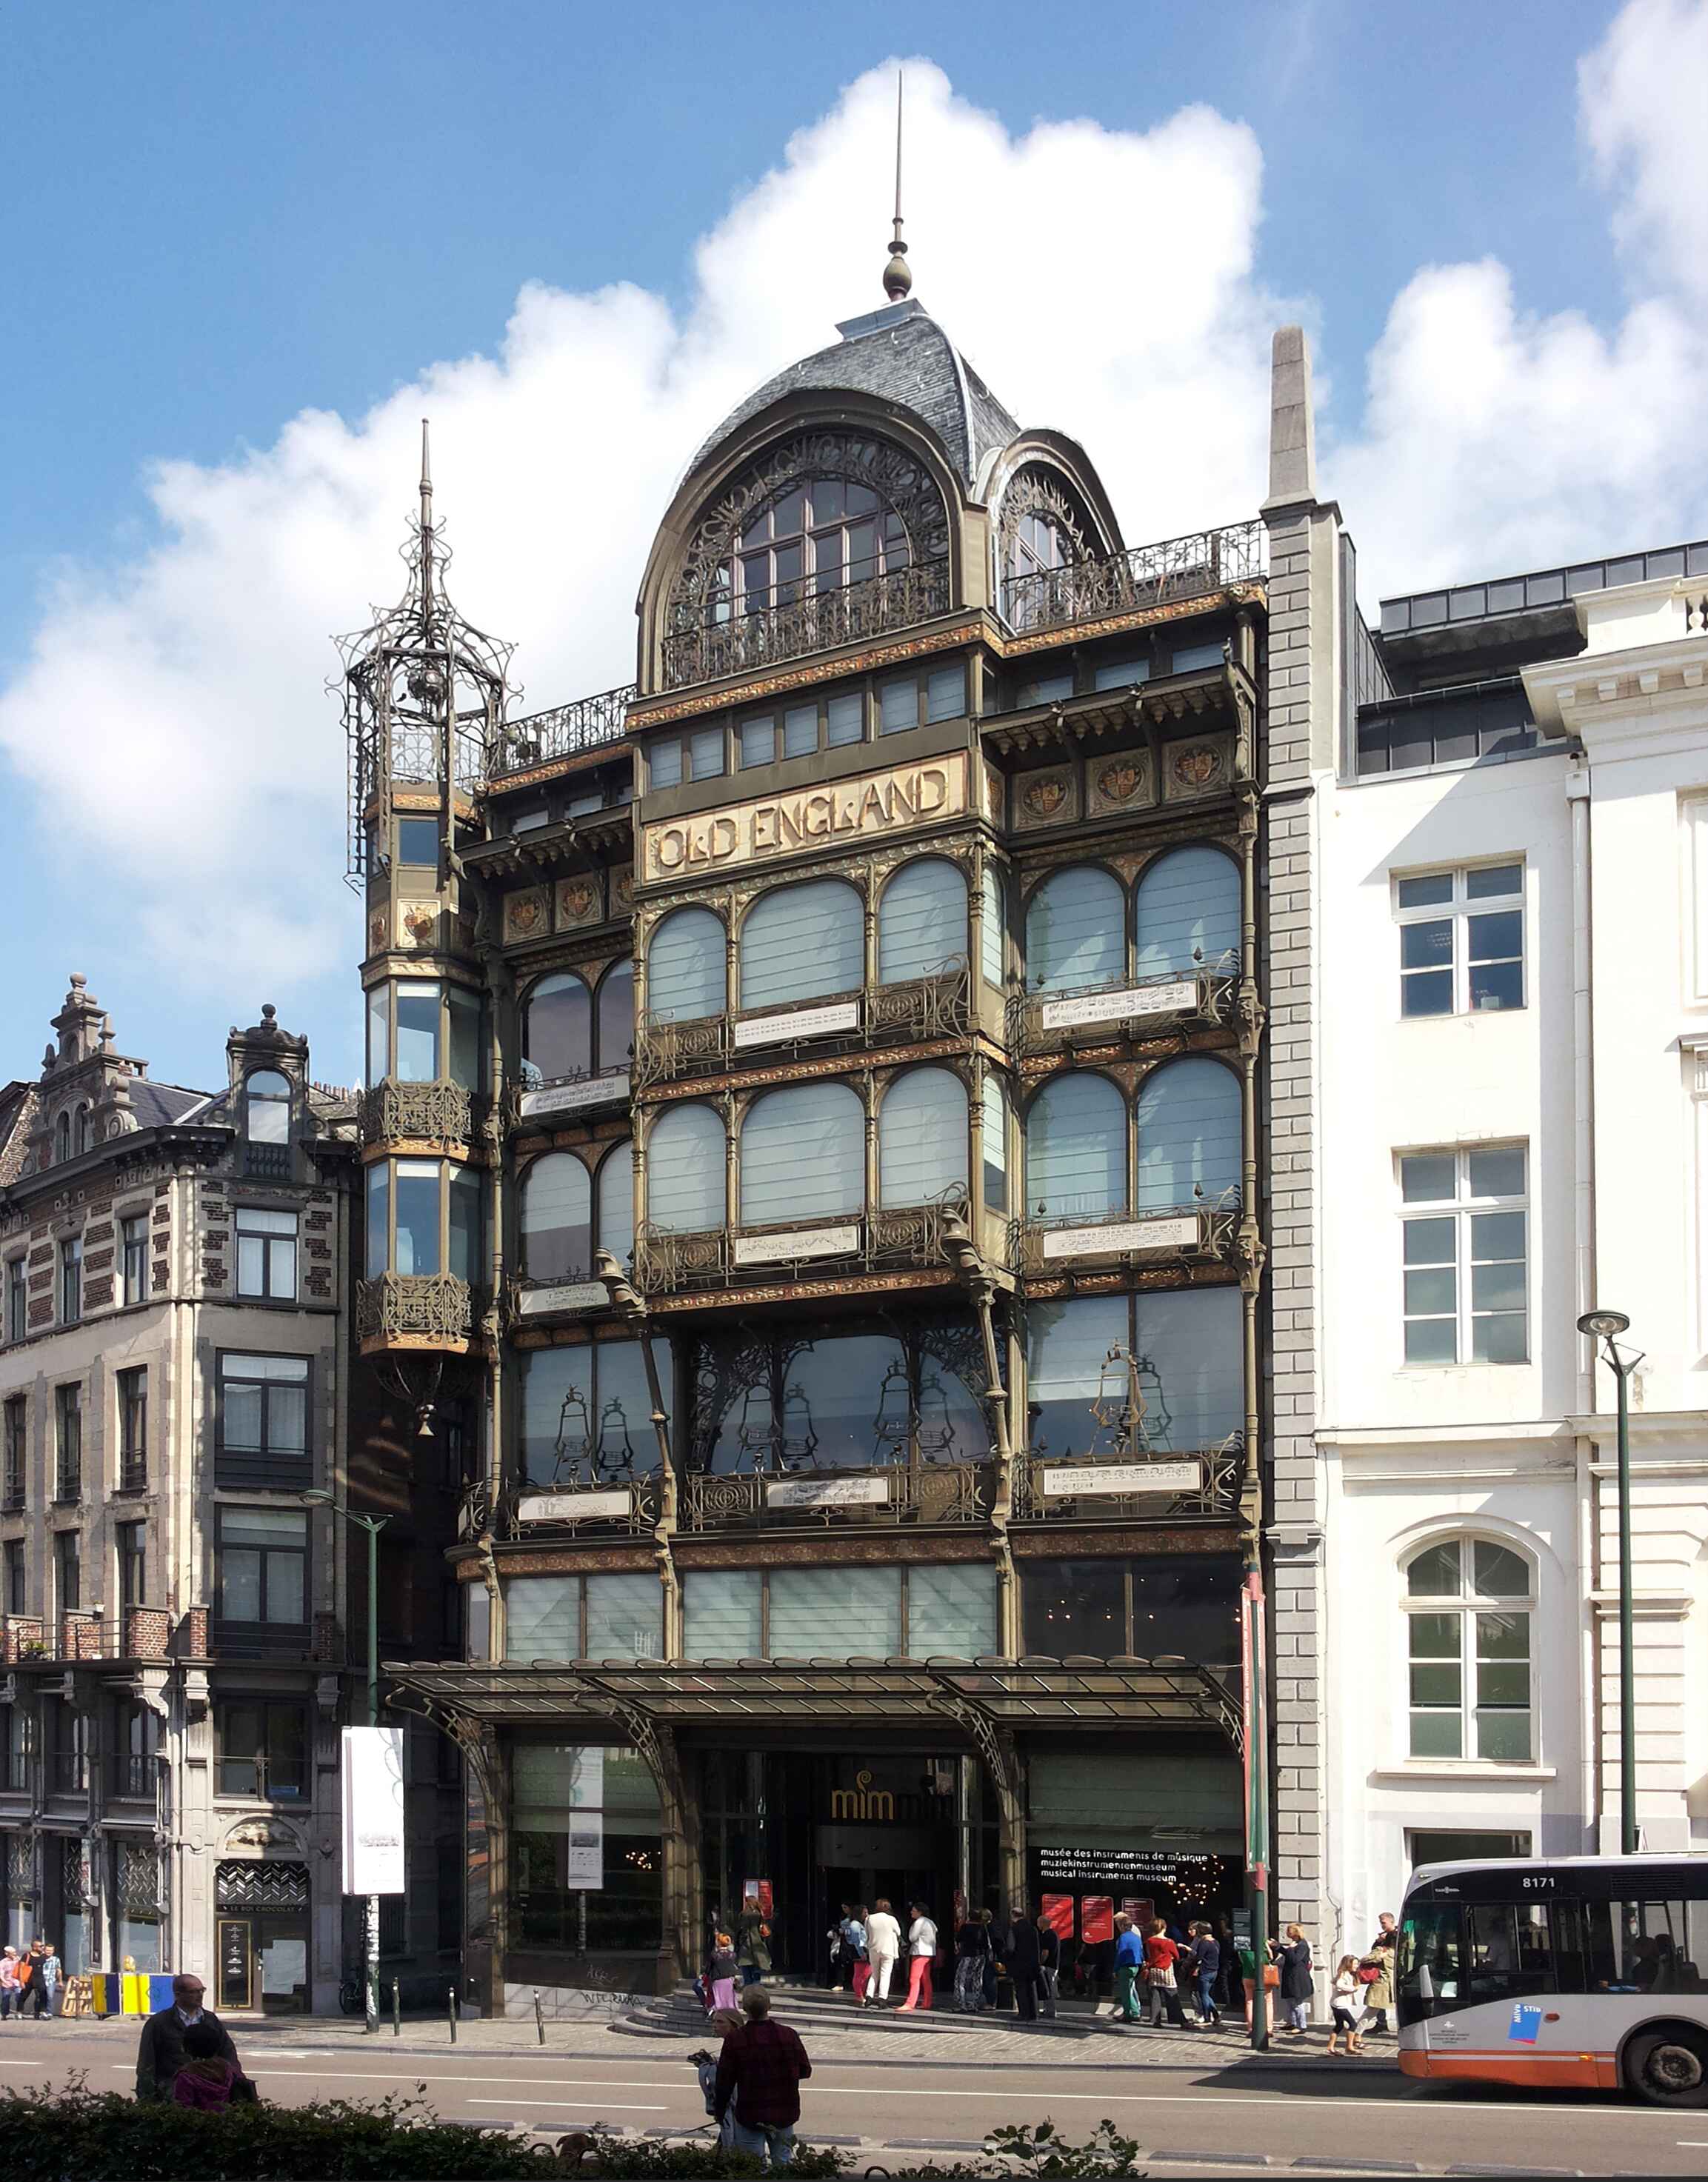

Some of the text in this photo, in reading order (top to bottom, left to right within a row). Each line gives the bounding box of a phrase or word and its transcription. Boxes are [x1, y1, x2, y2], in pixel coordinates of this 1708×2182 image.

[657, 769, 948, 869] OLD ENGLAND
[831, 1770, 894, 1820] mim
[1041, 1848, 1071, 1857] musée
[1073, 1849, 1091, 1858] des
[1093, 1849, 1150, 1860] instruments
[1152, 1852, 1164, 1861] de
[1041, 1859, 1176, 1871] muziekinstrumentenmuseum
[1041, 1869, 1176, 1882] musical instruments museum
[1522, 1878, 1555, 1888] 8171
